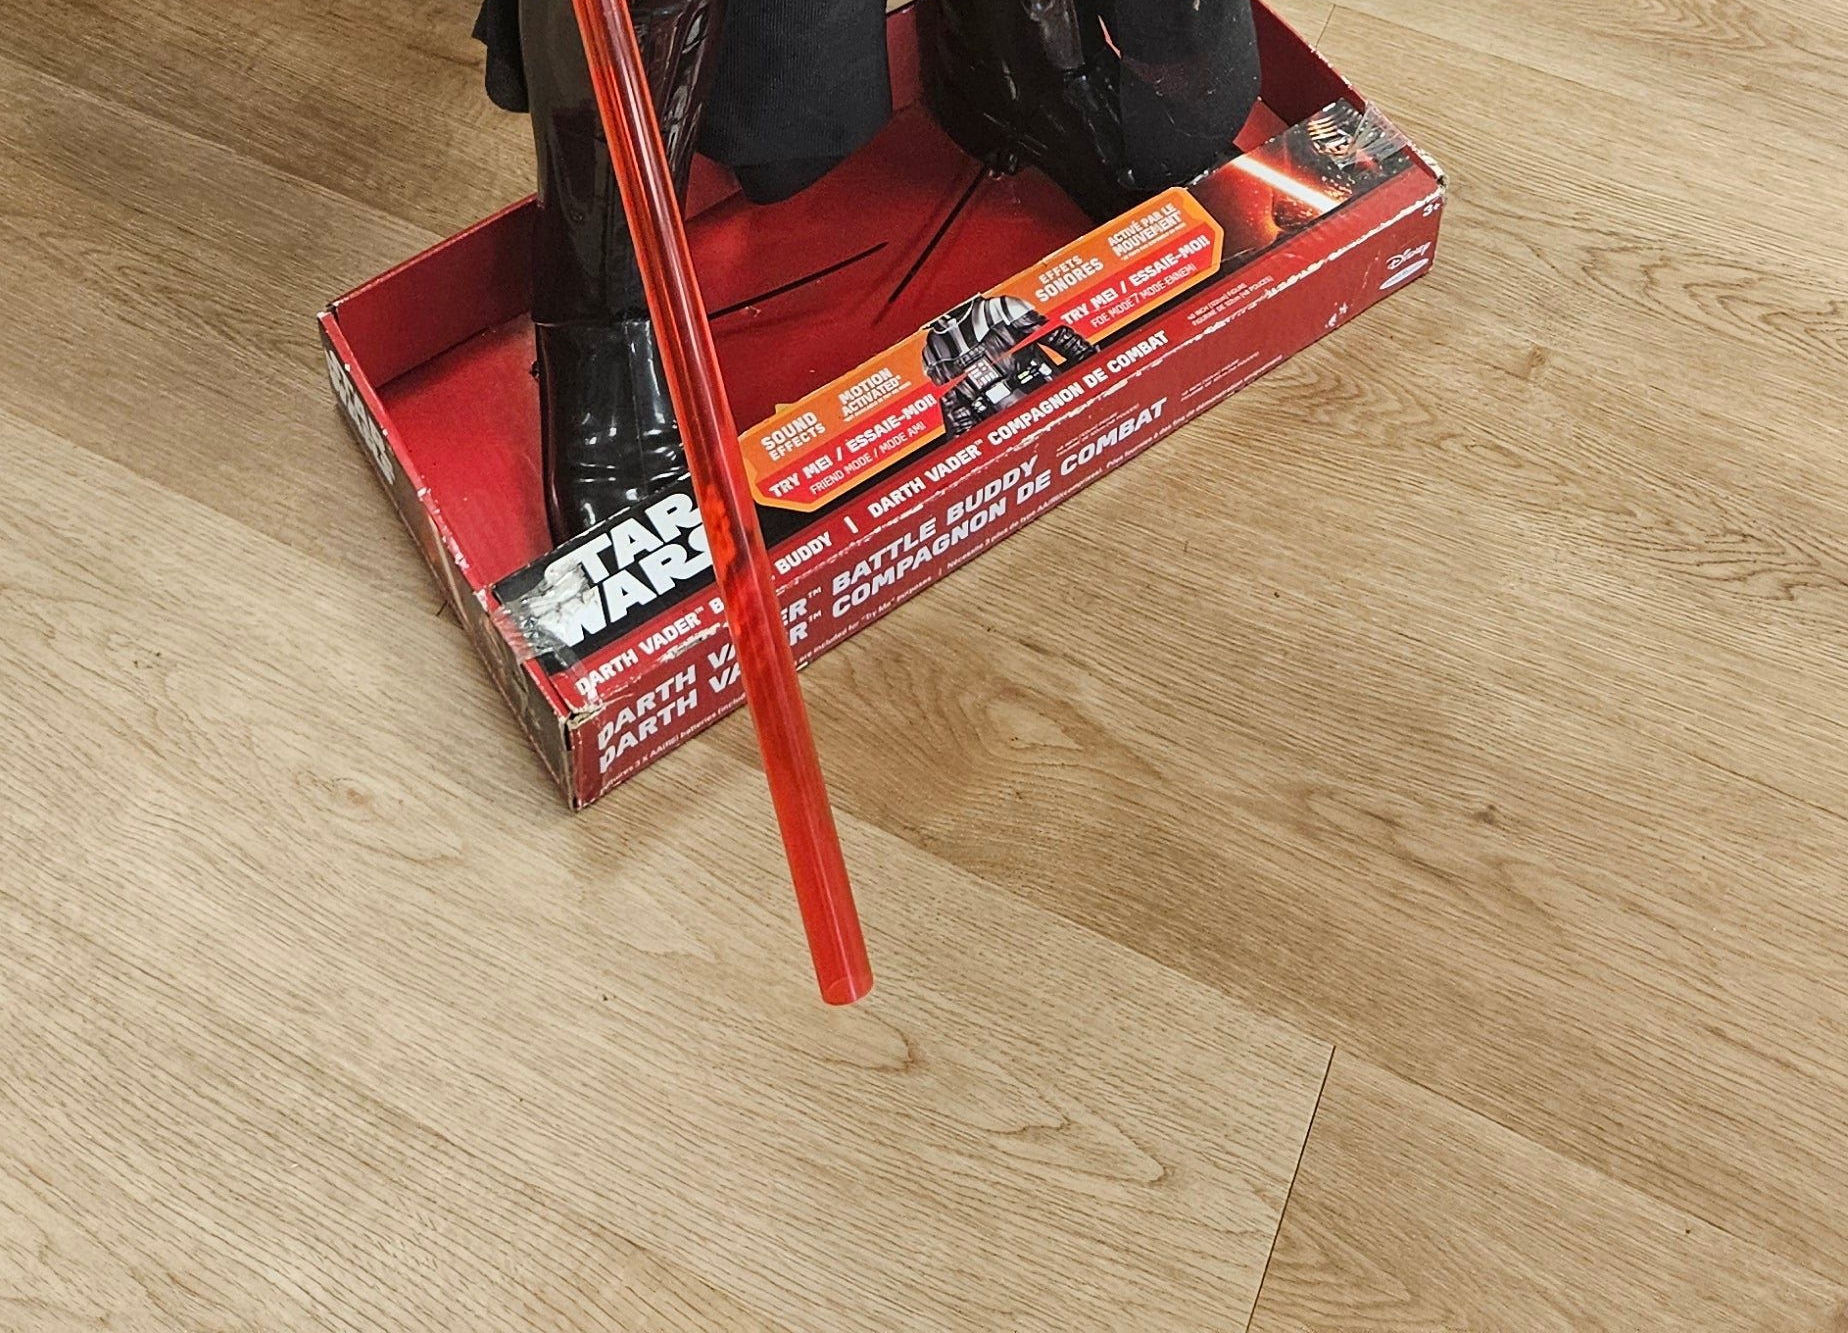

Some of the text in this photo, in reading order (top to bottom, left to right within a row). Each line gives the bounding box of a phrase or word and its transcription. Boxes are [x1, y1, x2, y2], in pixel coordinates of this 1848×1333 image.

[1107, 220, 1143, 246] ACTIVÉ
[1140, 211, 1163, 227] PAR
[1160, 203, 1177, 215] LE
[1422, 203, 1440, 217] 3+
[1034, 257, 1104, 303] SONORES
[1038, 255, 1083, 284] EFFETS
[1060, 303, 1090, 326] TRY
[1090, 287, 1119, 311] ME!
[1128, 234, 1210, 287] ESSAIE-MOI!
[1386, 241, 1431, 270] Disney
[1090, 311, 1108, 328] FOE
[1108, 298, 1135, 318] MODE
[838, 367, 893, 404] MOTION
[760, 411, 818, 450] SOUND
[768, 422, 826, 462] EFFECTS
[769, 472, 800, 497] TRY
[802, 454, 834, 479] ME!
[845, 393, 938, 454] ESSAIE-MOI!
[809, 470, 845, 495] FRIEND
[846, 453, 873, 475] MODE
[880, 432, 909, 454] MODE
[907, 421, 927, 438] AMI
[543, 493, 703, 585] STAR
[575, 648, 638, 696] DARTH
[774, 531, 833, 575] BUDDY
[867, 476, 926, 519] DARTH
[987, 381, 1085, 446] COMPAGNON
[1082, 367, 1109, 389] DE
[1106, 329, 1170, 374] COMBAT
[545, 524, 714, 647] WARS
[597, 454, 1039, 751] DARTH BATTLE BUDDY
[599, 688, 698, 774] DARTH
[832, 496, 1007, 619] COMPAGNON
[1016, 468, 1051, 505] DE
[1060, 396, 1168, 476] COMBAT
[678, 712, 717, 737] batteries
[812, 628, 847, 651] included
